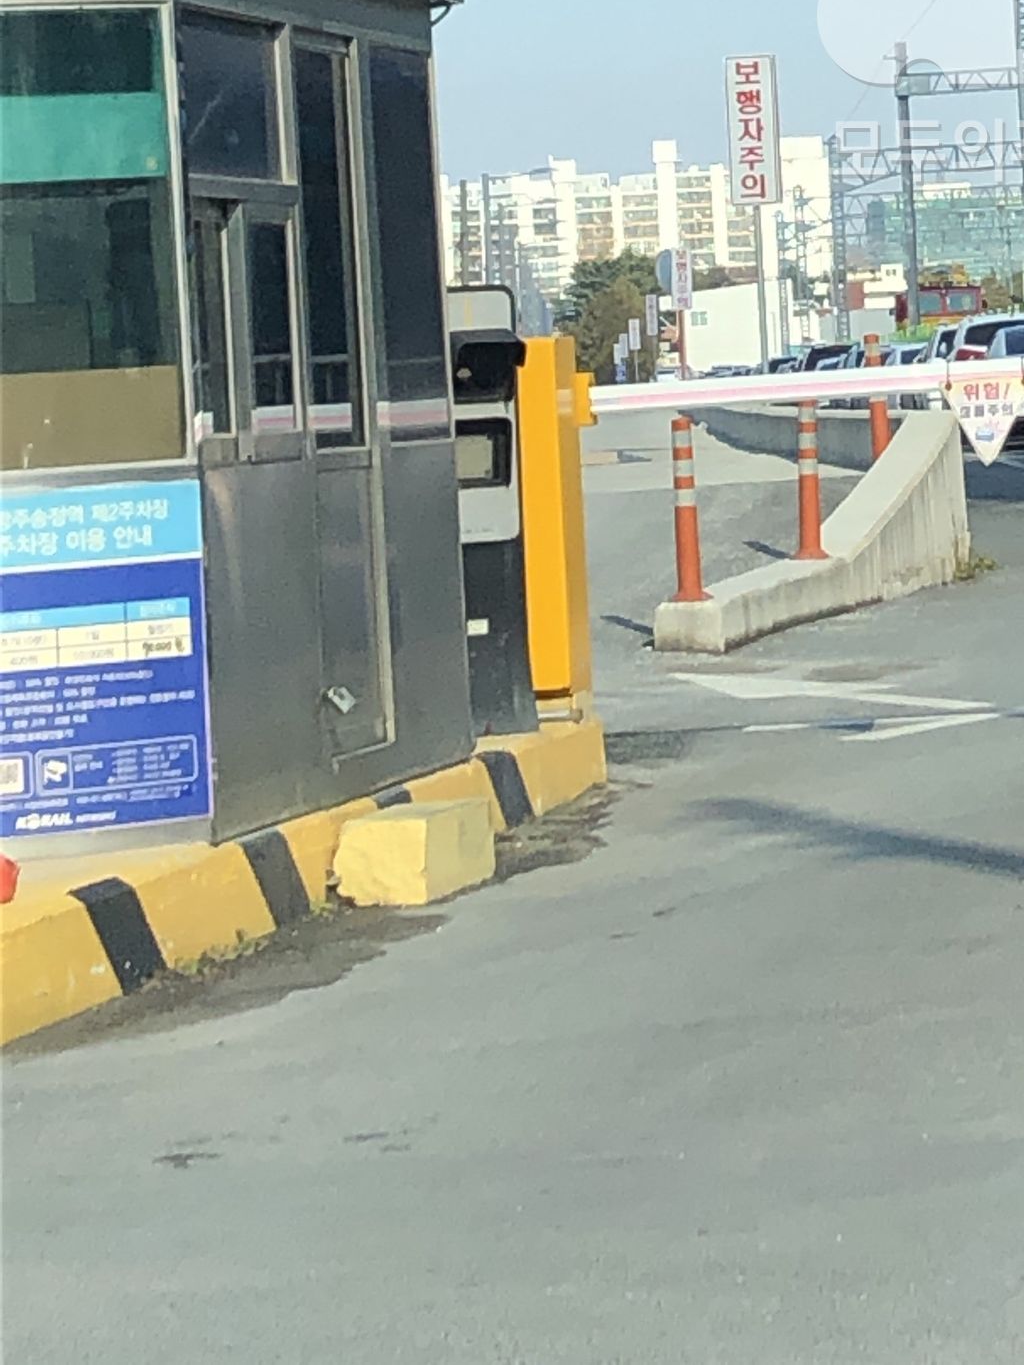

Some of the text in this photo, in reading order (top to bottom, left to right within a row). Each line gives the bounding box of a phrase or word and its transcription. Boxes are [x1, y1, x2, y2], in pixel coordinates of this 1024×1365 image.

[735, 60, 769, 200] 보행자주의
[65, 527, 106, 553] 이용
[113, 524, 153, 550] 안내
